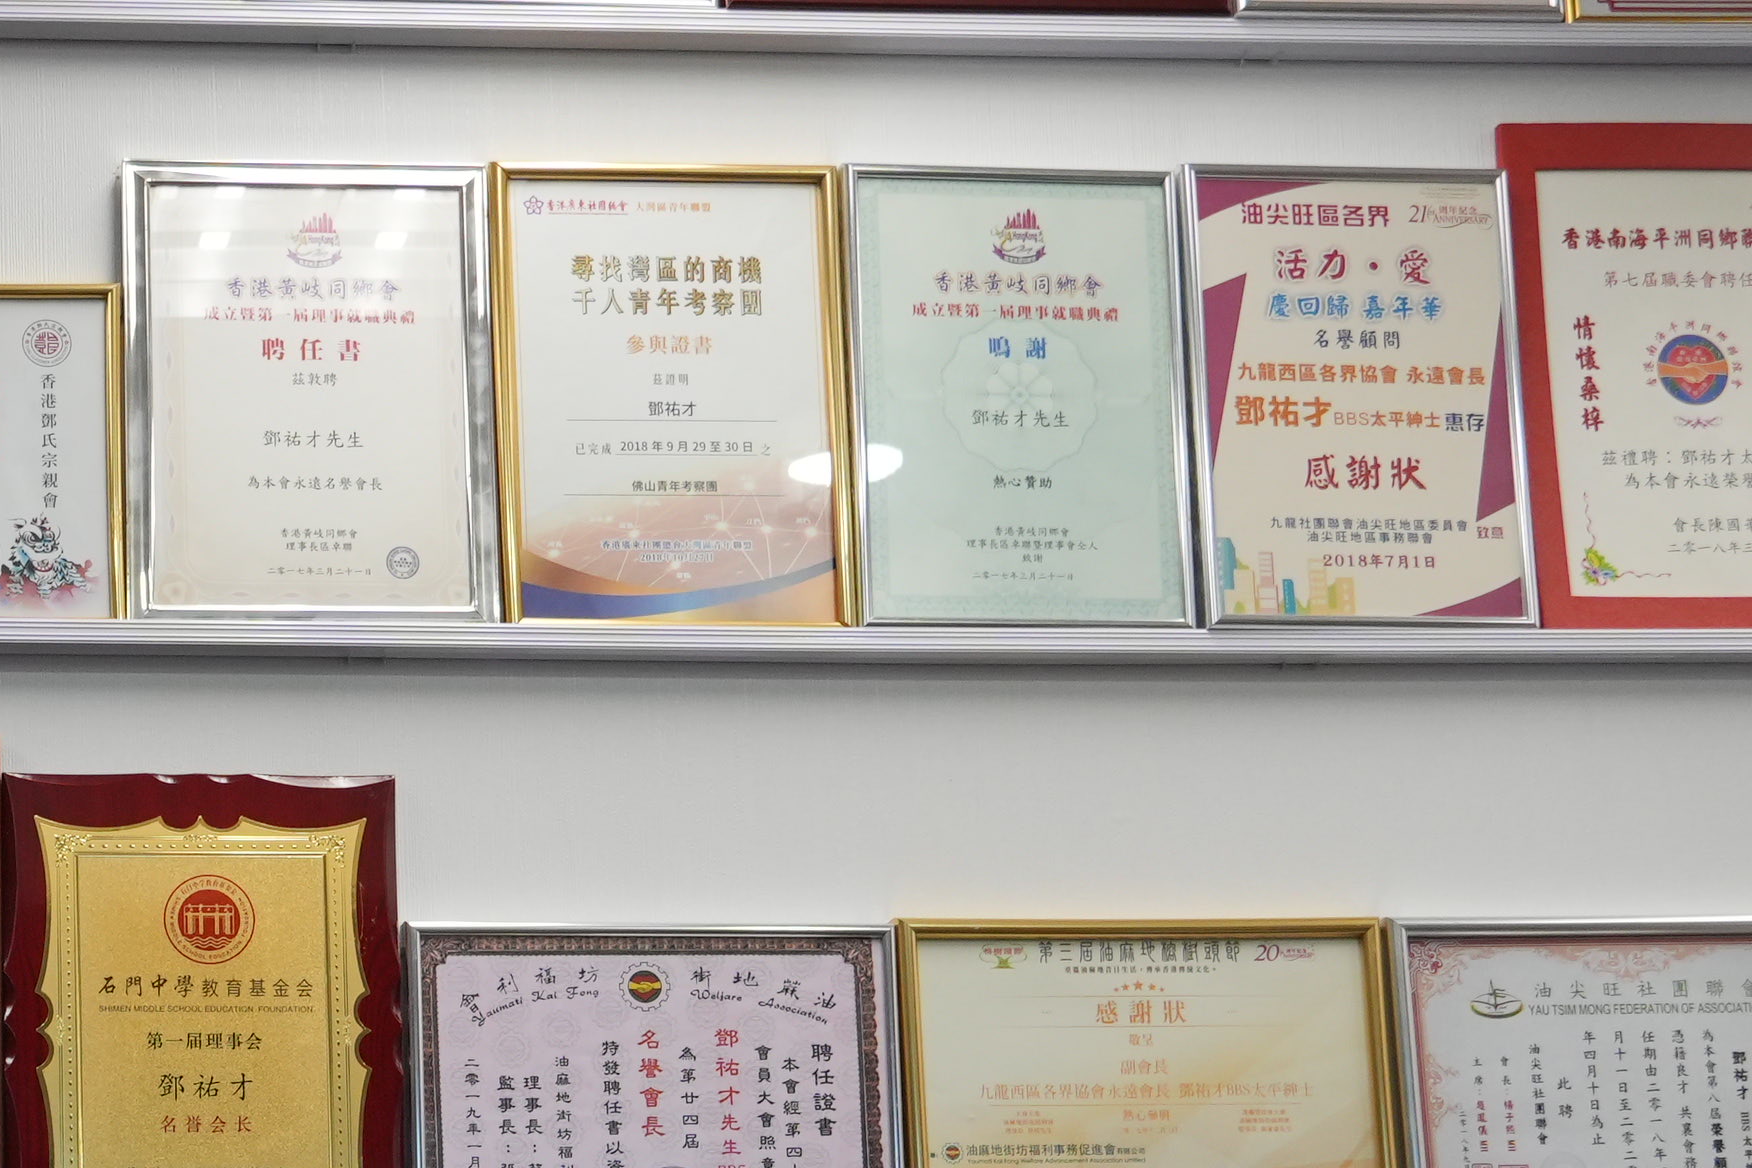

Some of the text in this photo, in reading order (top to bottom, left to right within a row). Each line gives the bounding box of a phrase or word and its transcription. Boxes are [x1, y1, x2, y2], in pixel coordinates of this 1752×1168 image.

[1241, 203, 1389, 227] 油尖旺區各界
[571, 255, 762, 284] 尋找灣區的商機
[227, 279, 400, 300] 香港黃岐同鄉會
[935, 273, 1102, 296] 香港黃岐同鄉會
[572, 288, 762, 316] 千人青年考察團
[1269, 294, 1444, 319] 慶回歸 嘉年華
[626, 335, 712, 354] 參與證書
[1314, 329, 1401, 348] 名譽顧問
[262, 339, 361, 361] 聘任書
[989, 337, 1046, 360] 鳴謝
[292, 373, 336, 386] 茲敦聘
[1238, 362, 1485, 385] 九龍西區各界協會 永遠會長
[1573, 316, 1604, 432] 情懷桑梓
[649, 402, 696, 417] 鄧祐才
[972, 410, 1069, 427] 鄧祐才先生
[41, 373, 58, 509] 香港鄧氏宗親會
[263, 431, 363, 448] 鄧祐才先生
[575, 443, 770, 455] 已完成 之
[1305, 454, 1427, 490] 感謝狀
[248, 476, 382, 490] 為本會永遠名譽會長
[632, 480, 717, 492] 佛山青年考察團
[1271, 517, 1467, 532] 九龍社團聯會油尖旺地區委員會
[1476, 525, 1504, 539] 致意
[1307, 531, 1433, 544] 油尖旺地區事務聯會
[1323, 554, 1436, 569] 2018年7月1日
[532, 989, 557, 1002] Kai
[567, 988, 599, 1000] Fong
[99, 1005, 314, 1013] SHIMEN MIDDLE SCHOOL EDUCATION FOUNDATION
[1096, 1001, 1186, 1023] 感謝狀
[1529, 1004, 1695, 1015] YAU TSIM MONG FEDERATION OF
[147, 1032, 262, 1050] 第一届理事会
[1121, 1059, 1168, 1075] 副會長
[158, 1074, 253, 1100] 鄧祐才
[638, 1029, 665, 1137] 名譽會長
[811, 1044, 835, 1137] 聘任證書
[1558, 1078, 1573, 1118] 此聘
[161, 1116, 252, 1133] 名誉会长
